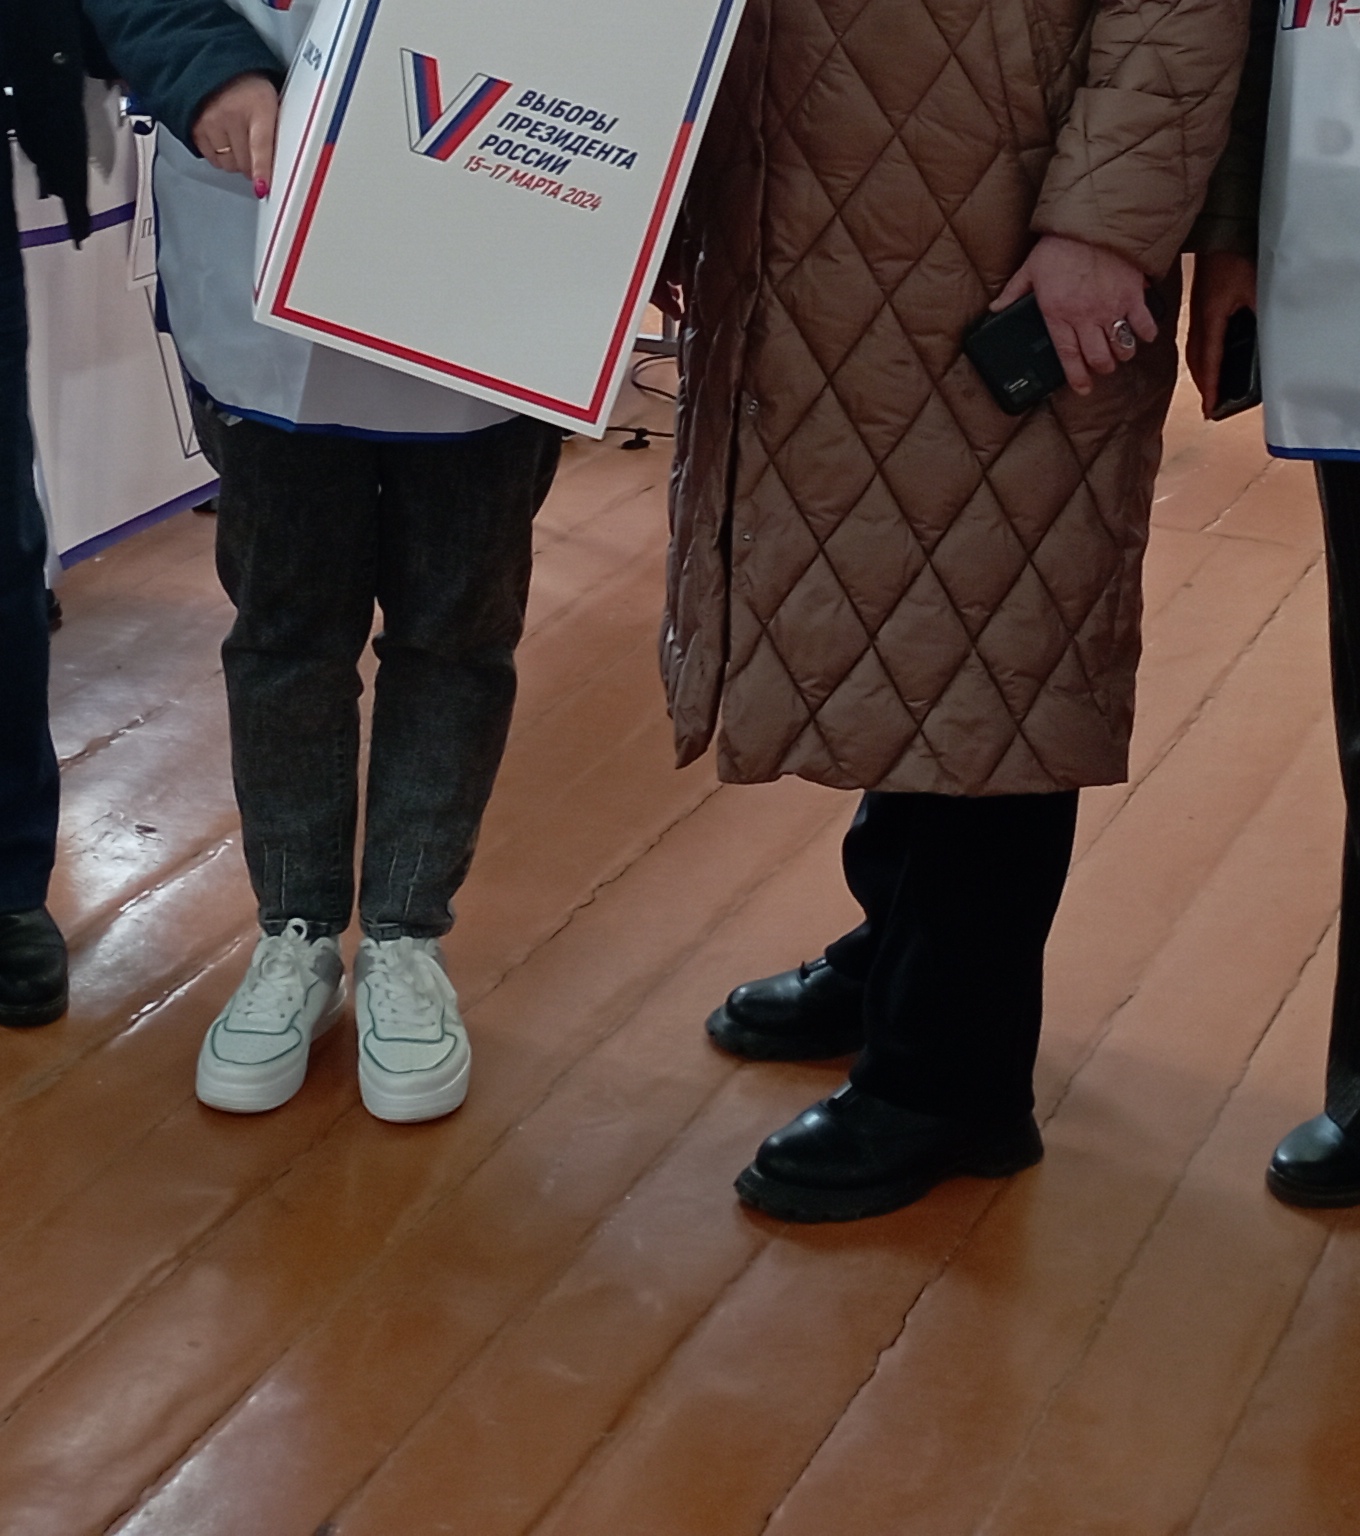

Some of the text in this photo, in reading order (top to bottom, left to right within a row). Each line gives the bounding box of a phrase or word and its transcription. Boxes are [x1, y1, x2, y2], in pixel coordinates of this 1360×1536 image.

[516, 89, 619, 135] ВЫБОРЫ
[478, 133, 572, 176] РОССИИ
[497, 111, 639, 170] ПРЕЗИДЕНТА
[505, 169, 564, 200] МАРТА
[559, 187, 602, 213] 2024
